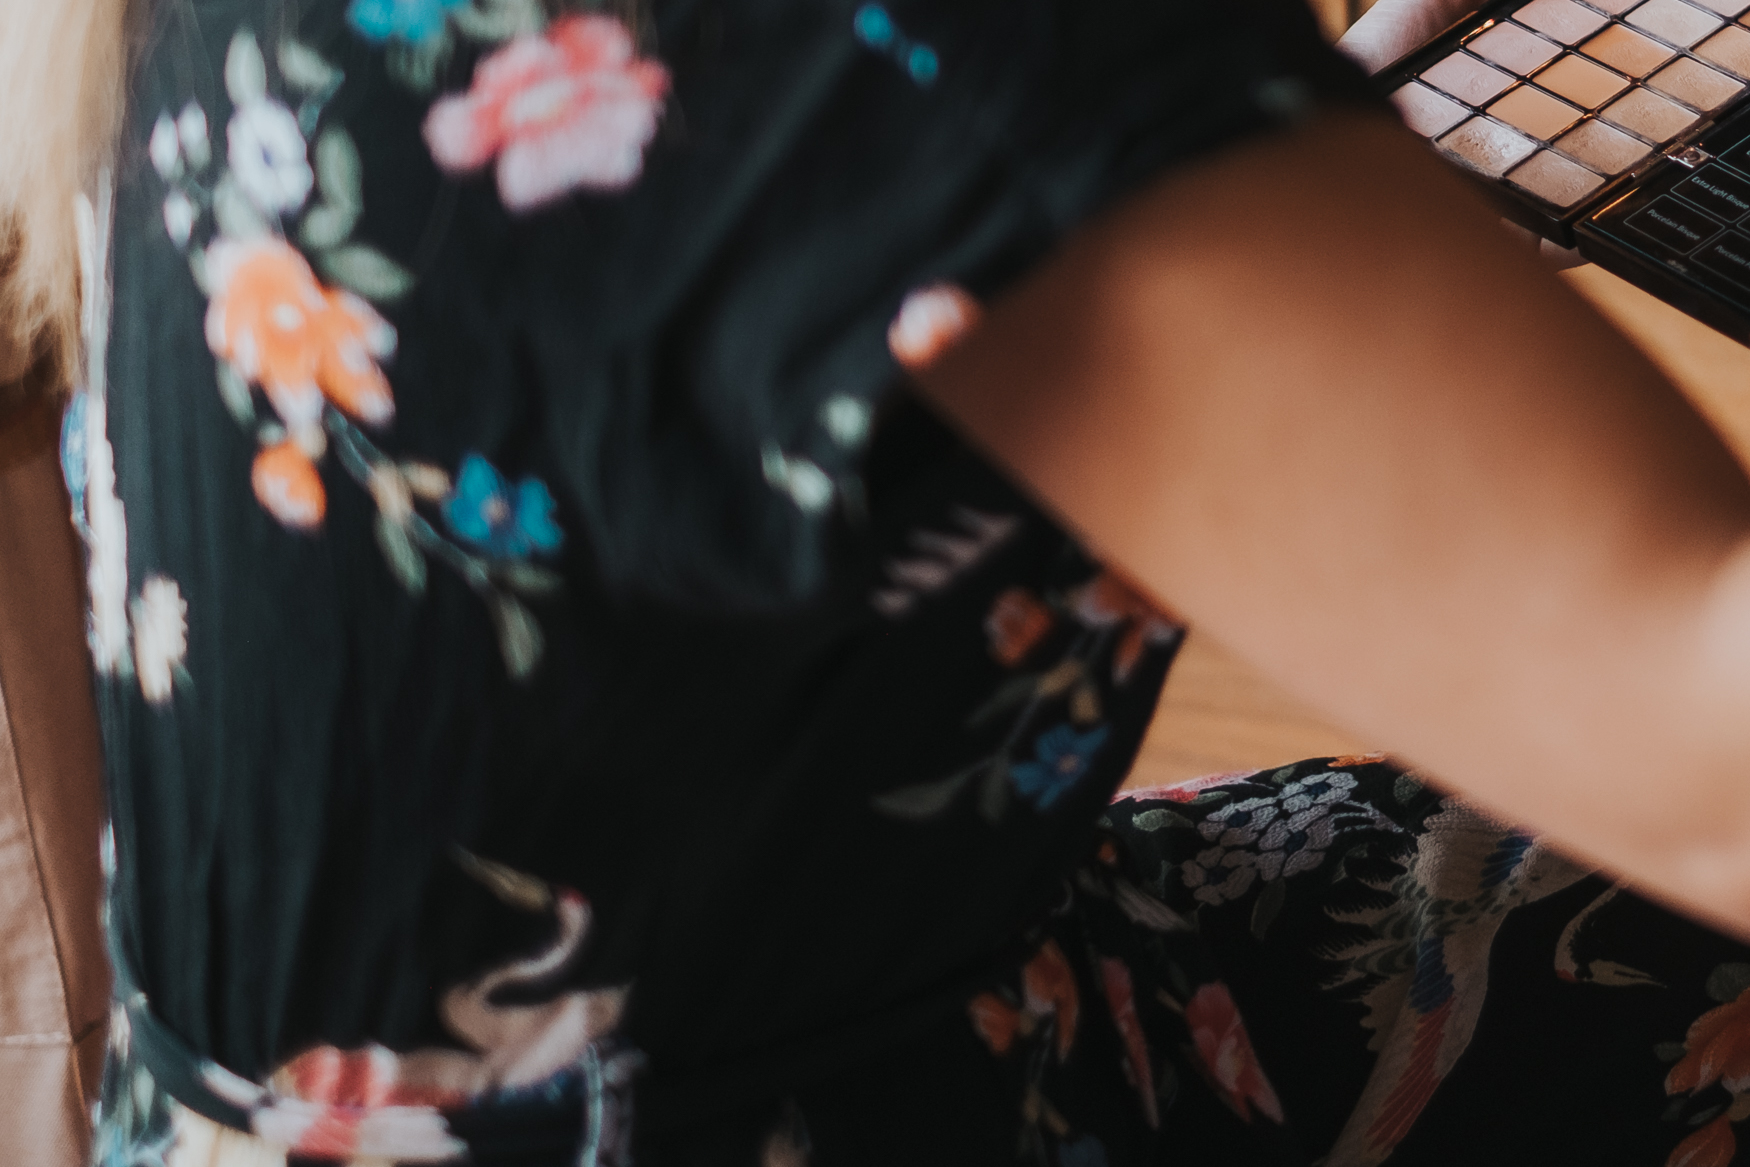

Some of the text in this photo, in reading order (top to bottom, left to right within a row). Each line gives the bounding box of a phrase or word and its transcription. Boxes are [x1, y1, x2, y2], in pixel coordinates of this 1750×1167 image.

[1691, 176, 1750, 210] Extra Light Bisque
[1647, 209, 1701, 241] Porcelain Bisque
